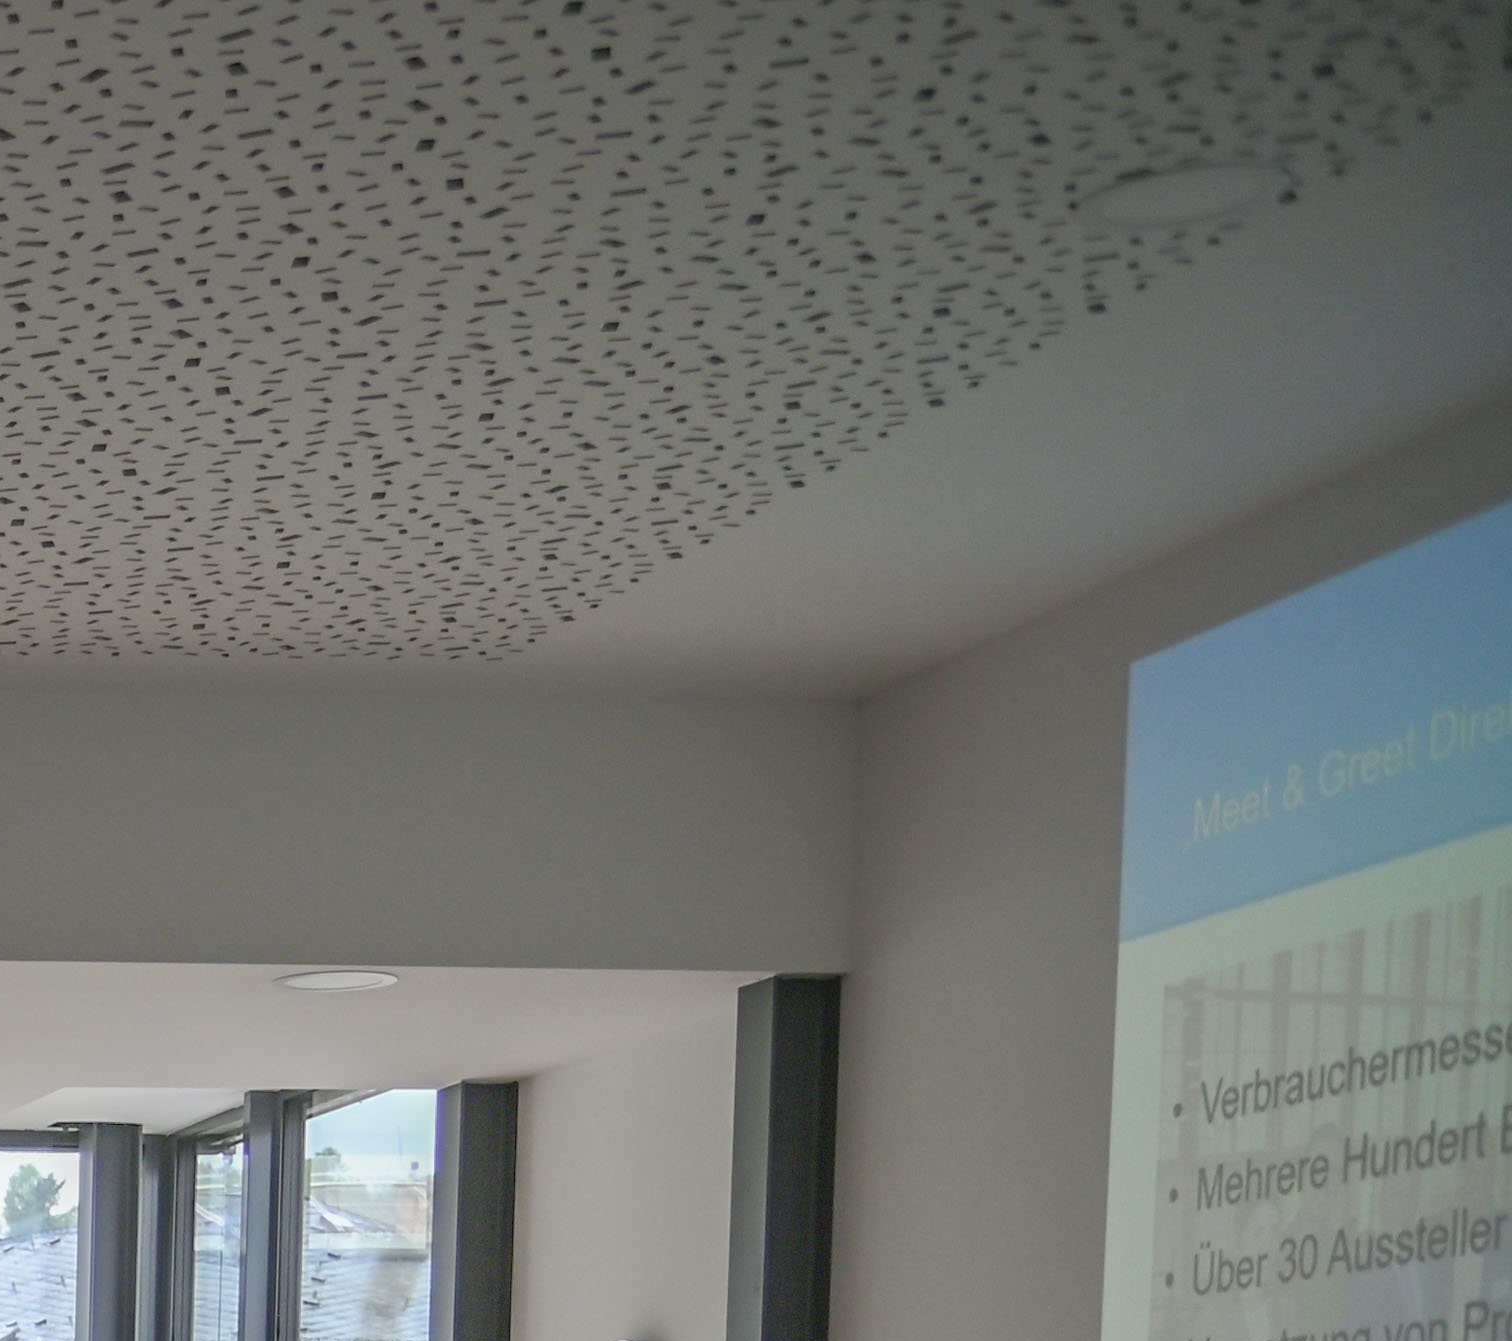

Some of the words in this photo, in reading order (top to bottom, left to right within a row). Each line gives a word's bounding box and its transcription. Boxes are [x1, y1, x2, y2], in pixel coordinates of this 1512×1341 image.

[1318, 724, 1419, 798] Greet
[1428, 690, 1512, 761] Dire
[1197, 1154, 1329, 1212] Mehrere
[1343, 1111, 1486, 1184] Hundert
[1193, 1241, 1268, 1296] Über
[1278, 1233, 1318, 1284] 30
[1326, 1207, 1509, 1277] Aussteller
